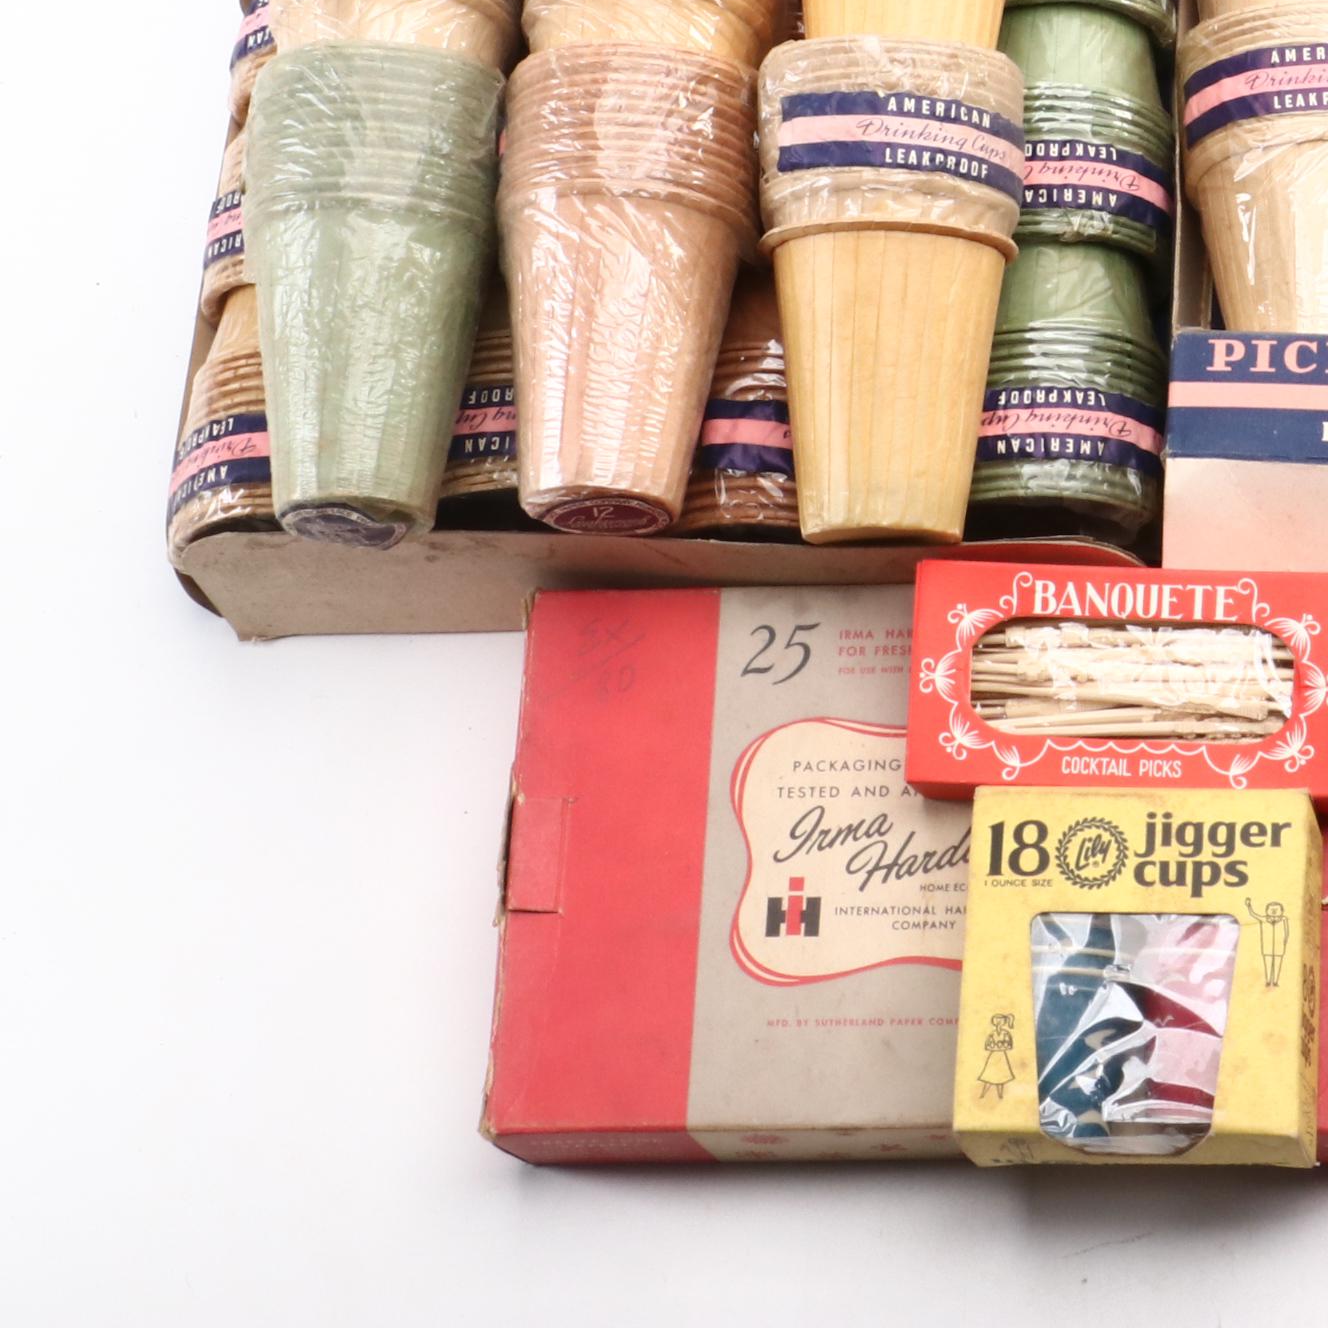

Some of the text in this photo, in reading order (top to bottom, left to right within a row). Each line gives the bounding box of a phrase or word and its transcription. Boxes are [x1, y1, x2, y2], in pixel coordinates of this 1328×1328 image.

[887, 96, 991, 128] AMERICAN
[885, 147, 988, 179] LEAKPROOF
[997, 389, 1105, 406] LEAKPROOF
[996, 436, 1104, 456] AMERICAN
[1032, 580, 1239, 622] BANQUETE
[839, 629, 874, 640] IRMA
[740, 622, 821, 685] 25
[838, 647, 866, 656] FOR
[793, 759, 902, 772] PACKAGING
[1061, 756, 1181, 778] COCKTAIL PICKS
[778, 786, 890, 799] TESTED AND
[773, 806, 893, 863] Irma
[1136, 811, 1292, 858] jigger
[987, 820, 1112, 876] 18 Lily
[920, 883, 950, 892] HOME
[991, 879, 1052, 887] OUNCE SIZE
[1133, 858, 1249, 898] cups
[835, 907, 936, 915] INTERNATIONAL
[892, 921, 956, 930] COMPANY
